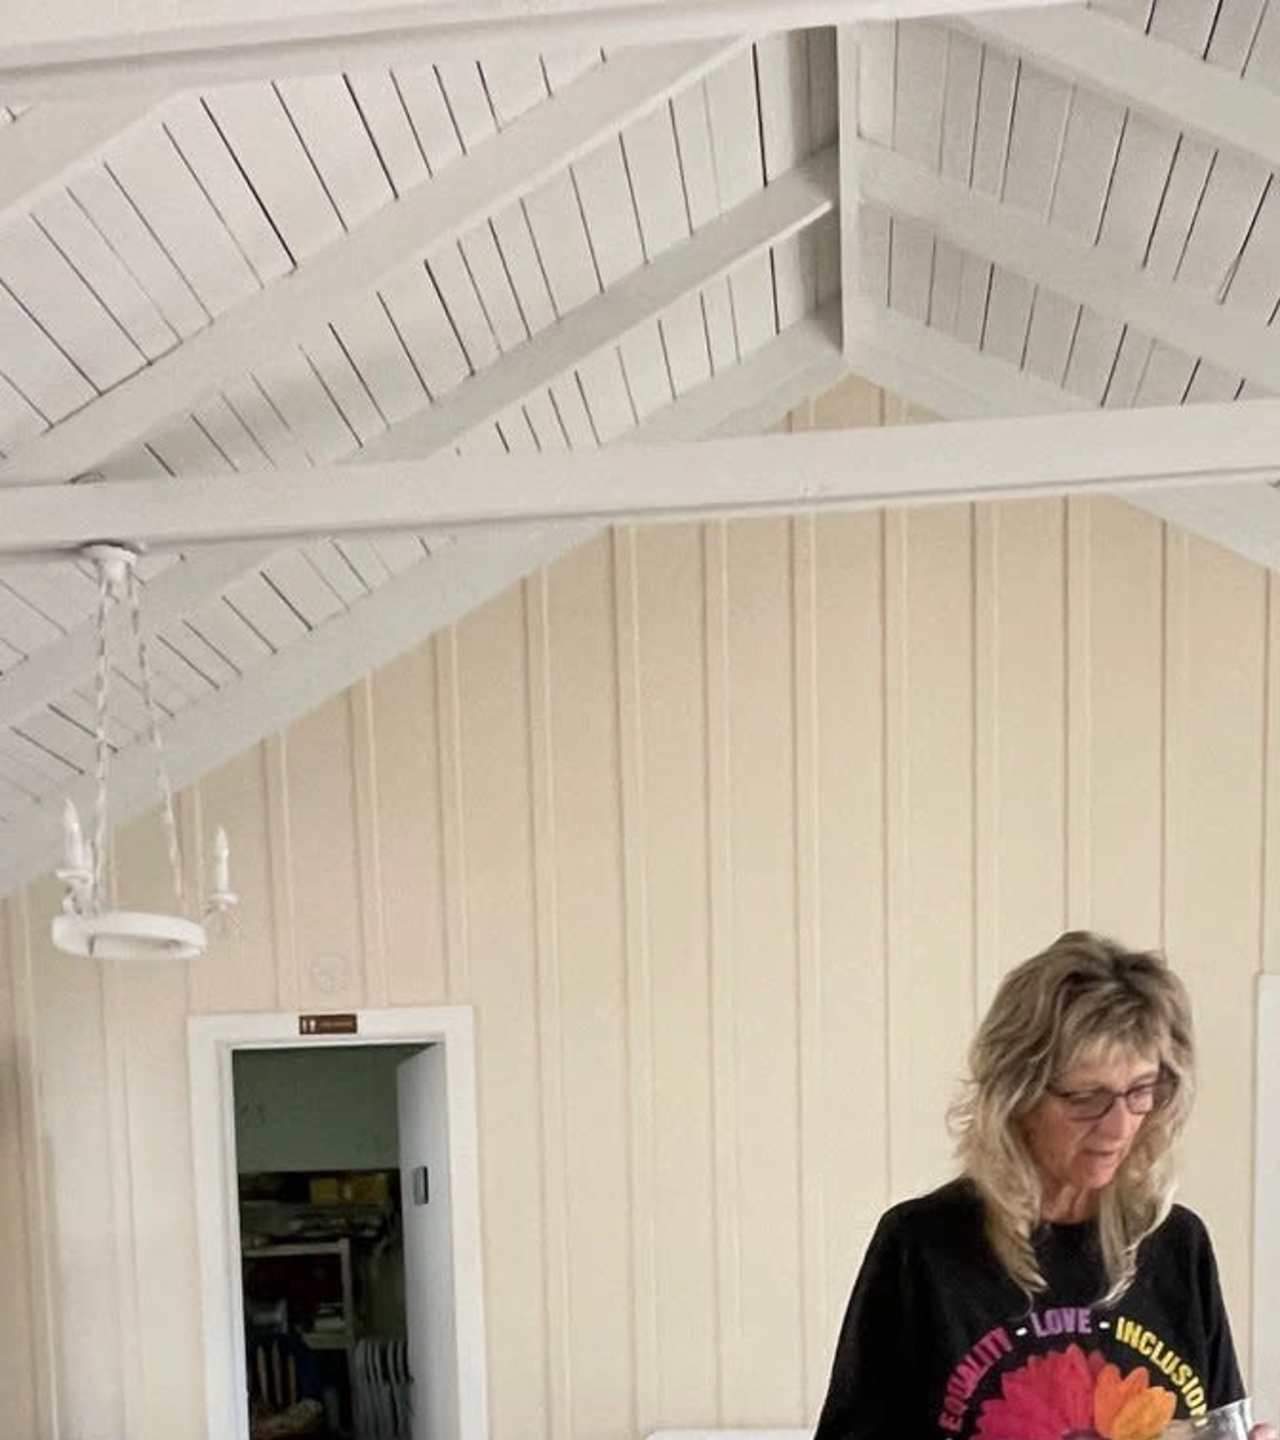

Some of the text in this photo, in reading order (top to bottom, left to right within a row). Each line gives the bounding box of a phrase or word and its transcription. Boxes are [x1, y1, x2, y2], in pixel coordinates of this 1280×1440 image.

[938, 1307, 1208, 1432] EQUALITY LOVE INCLUSION
